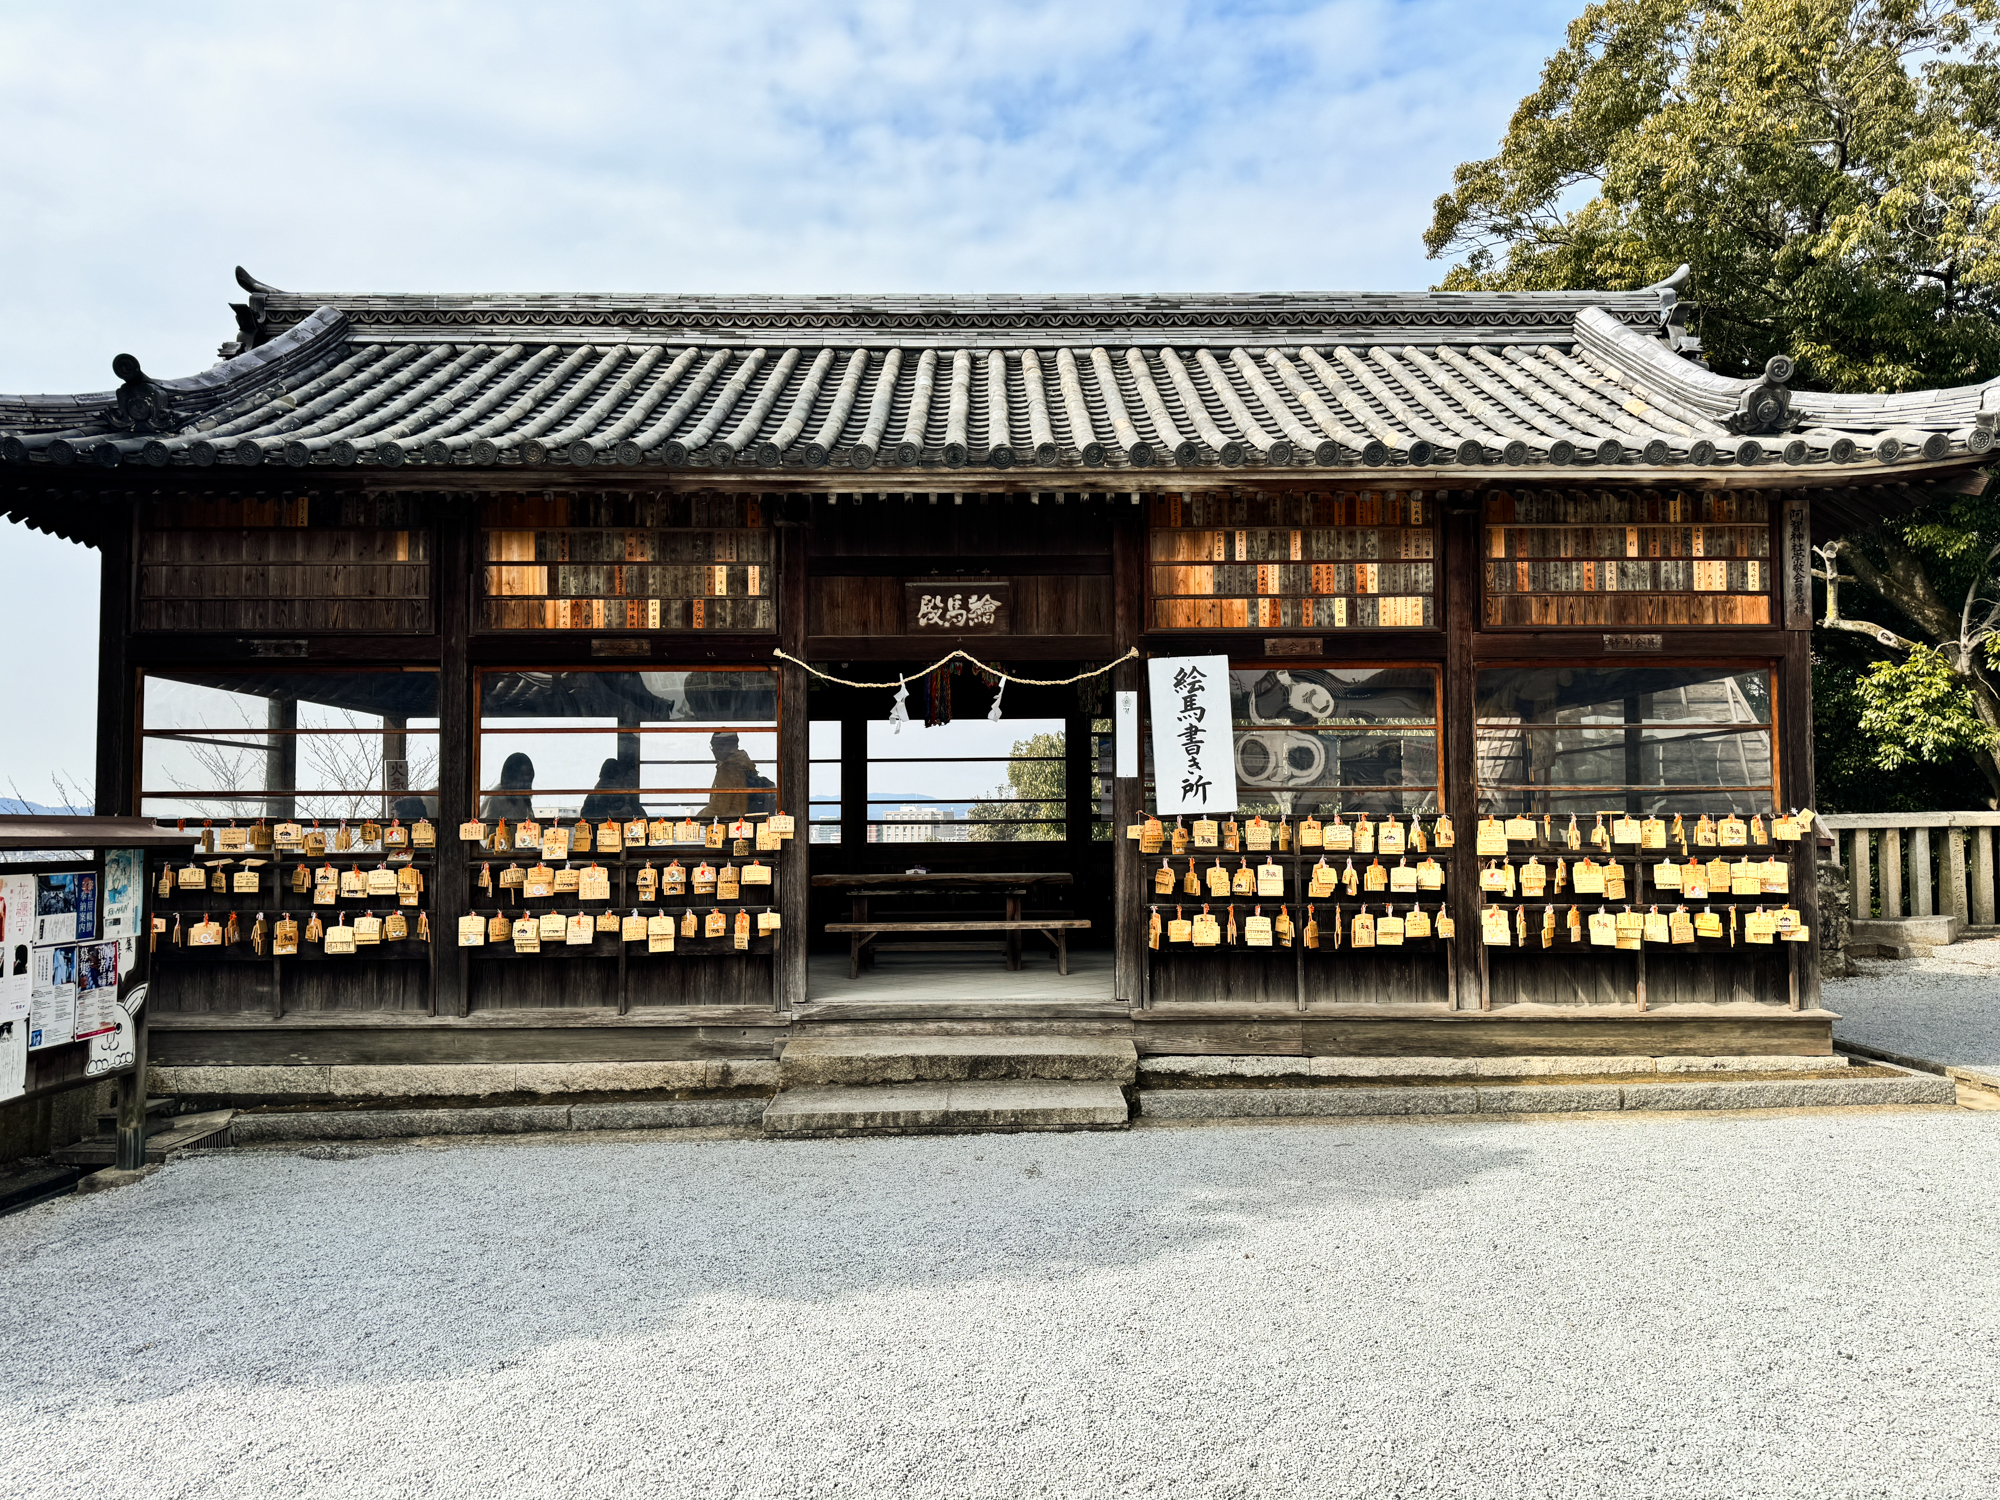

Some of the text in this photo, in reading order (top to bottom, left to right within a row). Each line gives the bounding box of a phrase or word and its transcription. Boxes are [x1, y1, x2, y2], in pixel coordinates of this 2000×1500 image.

[1172, 665, 1213, 806] 絵馬書き所
[79, 946, 89, 977] 募集
